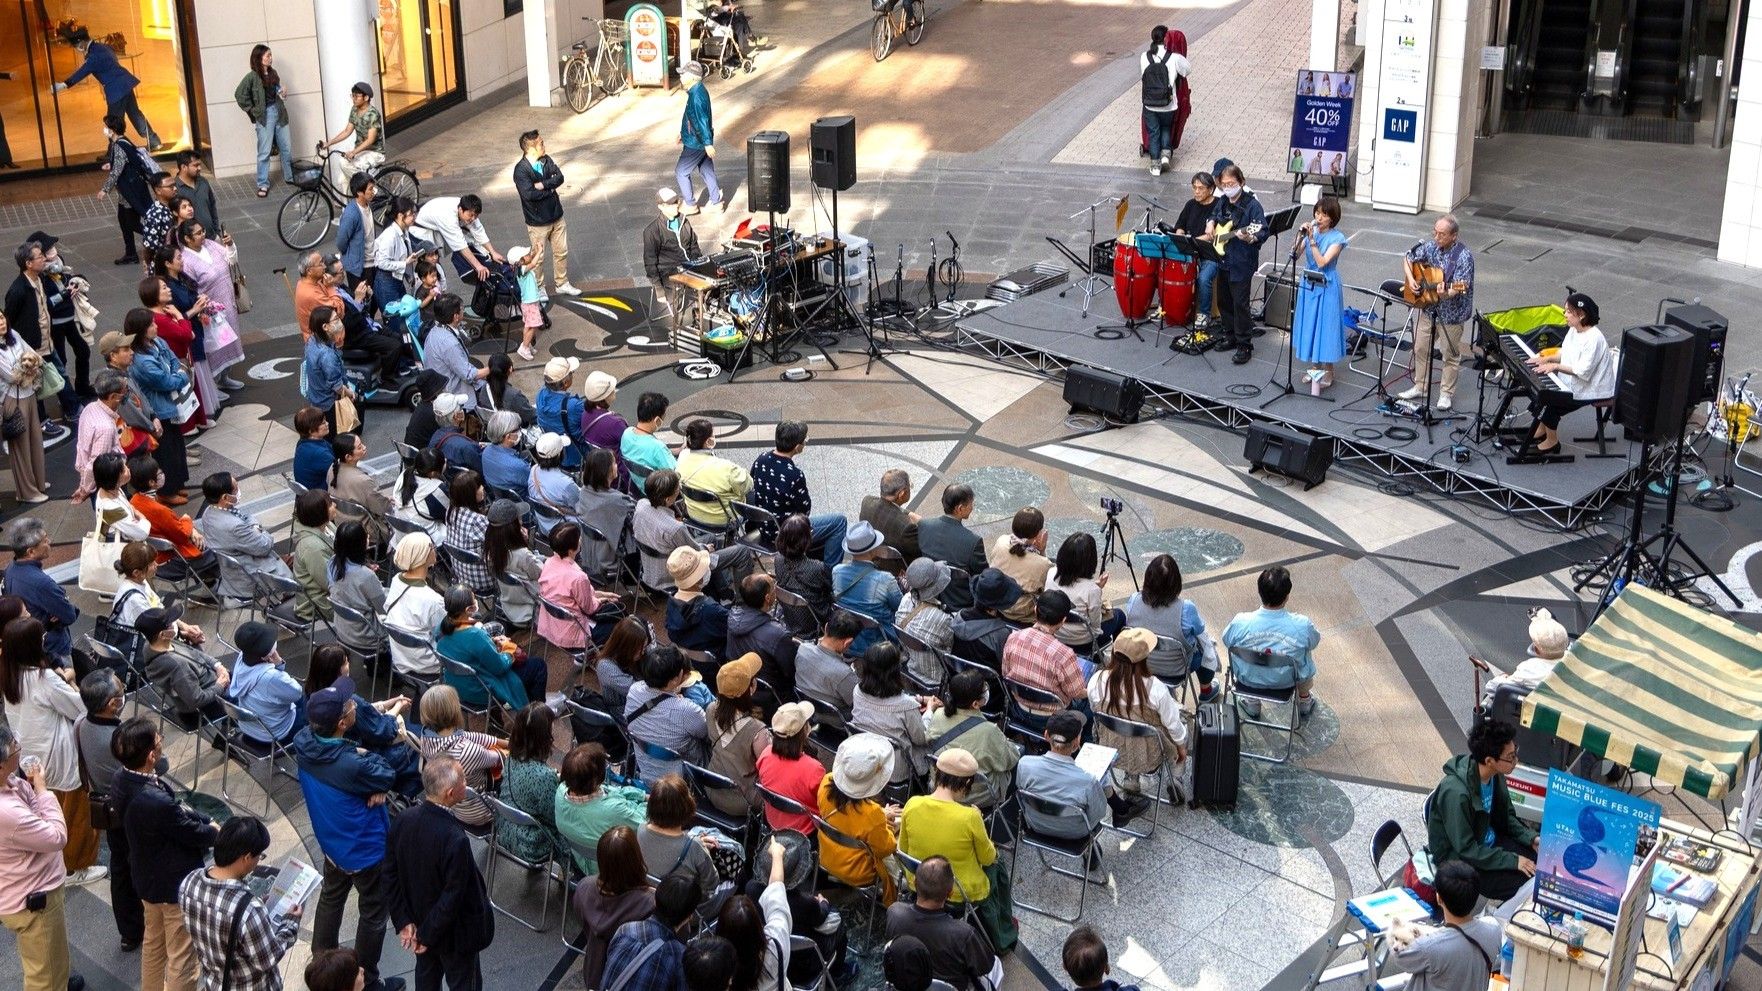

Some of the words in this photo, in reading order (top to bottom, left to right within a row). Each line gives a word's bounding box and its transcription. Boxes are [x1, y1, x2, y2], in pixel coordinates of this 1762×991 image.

[1306, 99, 1326, 107] Golden
[1304, 108, 1340, 126] 40%
[1391, 118, 1409, 133] GAP
[1313, 136, 1327, 147] GAP
[1506, 779, 1533, 791] SUZUKI
[1553, 774, 1596, 794] TAKAMATSU
[1552, 782, 1581, 798] MUSIC
[1583, 792, 1608, 808] BLUE
[1611, 801, 1629, 814] FES
[1632, 808, 1655, 823] 2025
[1555, 823, 1575, 835] UTAU
